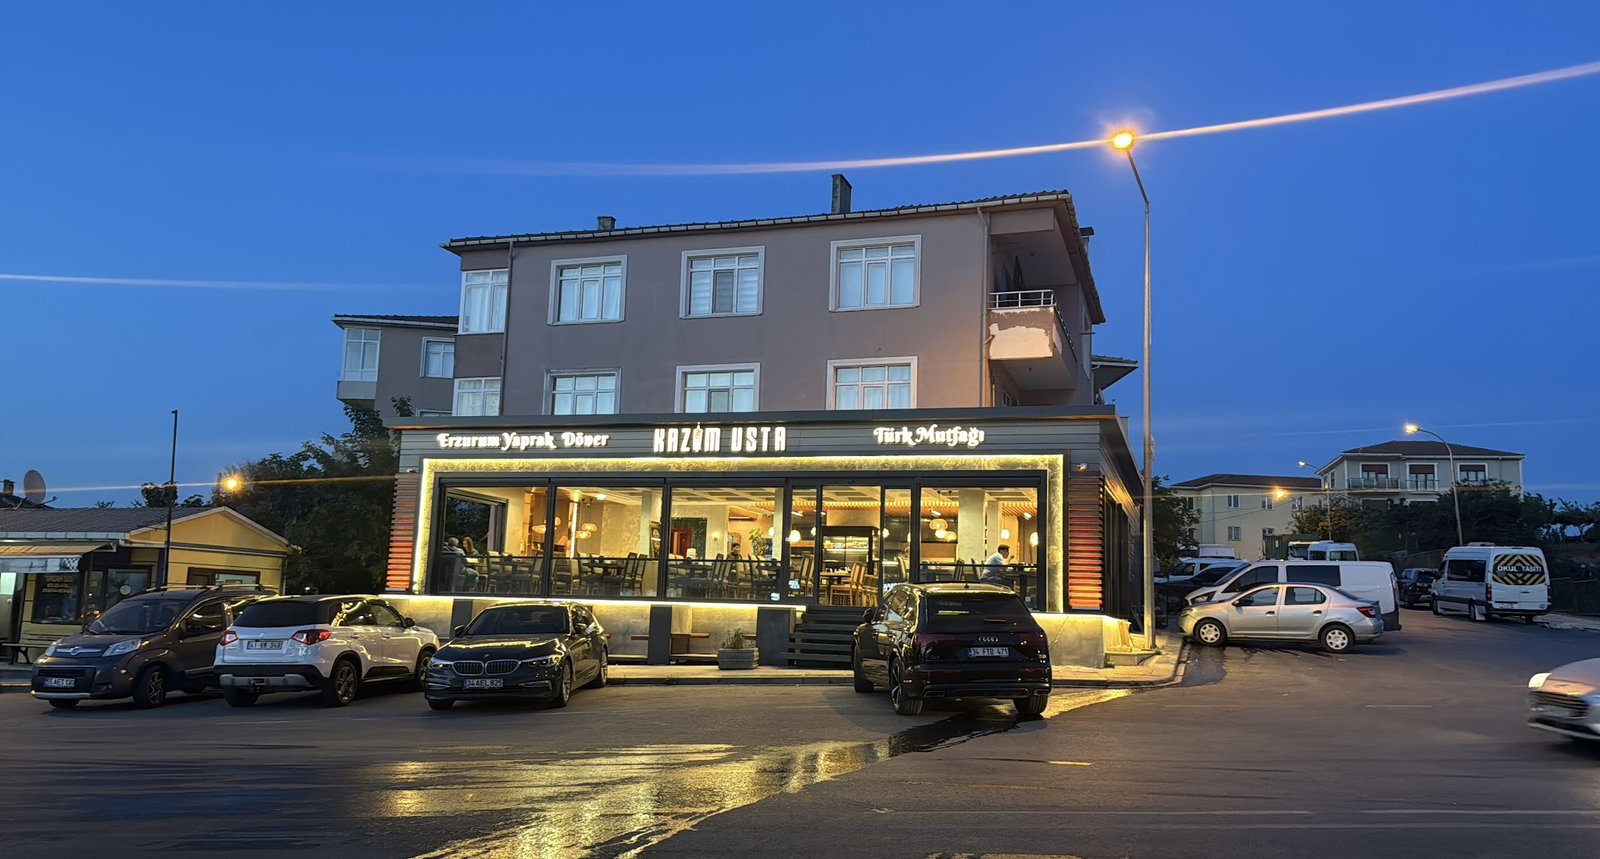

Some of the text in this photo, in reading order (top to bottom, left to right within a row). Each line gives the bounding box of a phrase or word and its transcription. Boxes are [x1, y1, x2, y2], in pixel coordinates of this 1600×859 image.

[437, 431, 609, 450] Erzurum Yaprak Döner
[731, 427, 786, 452] USTA
[873, 424, 985, 447] Türk Mutfağı
